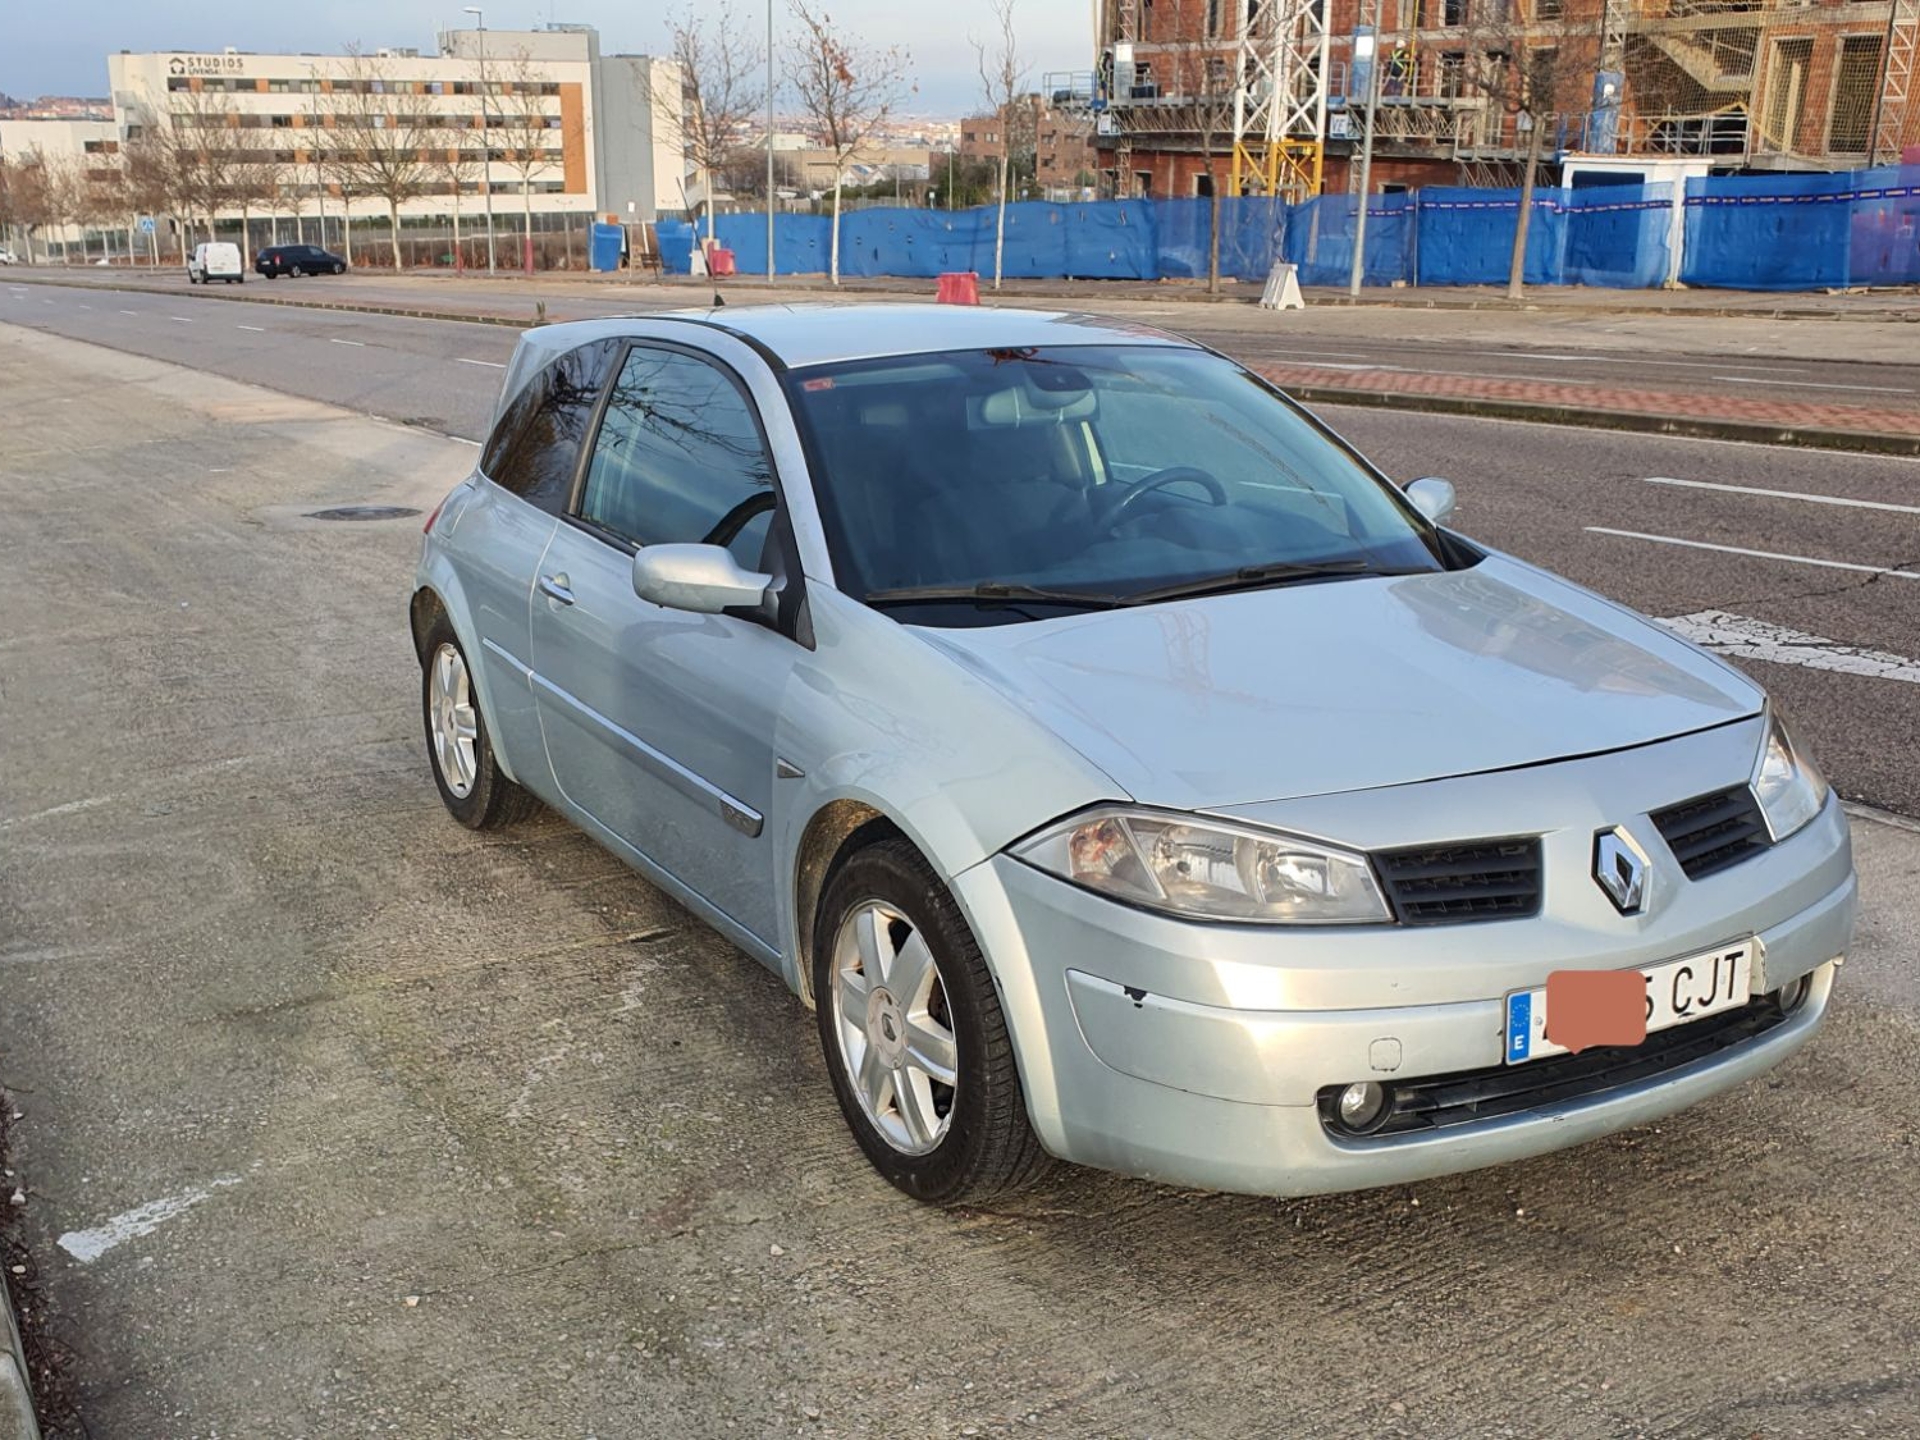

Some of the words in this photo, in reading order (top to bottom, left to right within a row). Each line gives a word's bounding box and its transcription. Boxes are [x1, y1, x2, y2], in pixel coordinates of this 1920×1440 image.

[188, 57, 243, 68] STUDIOS
[1514, 1034, 1525, 1050] E
[1672, 950, 1744, 1014] CJT
